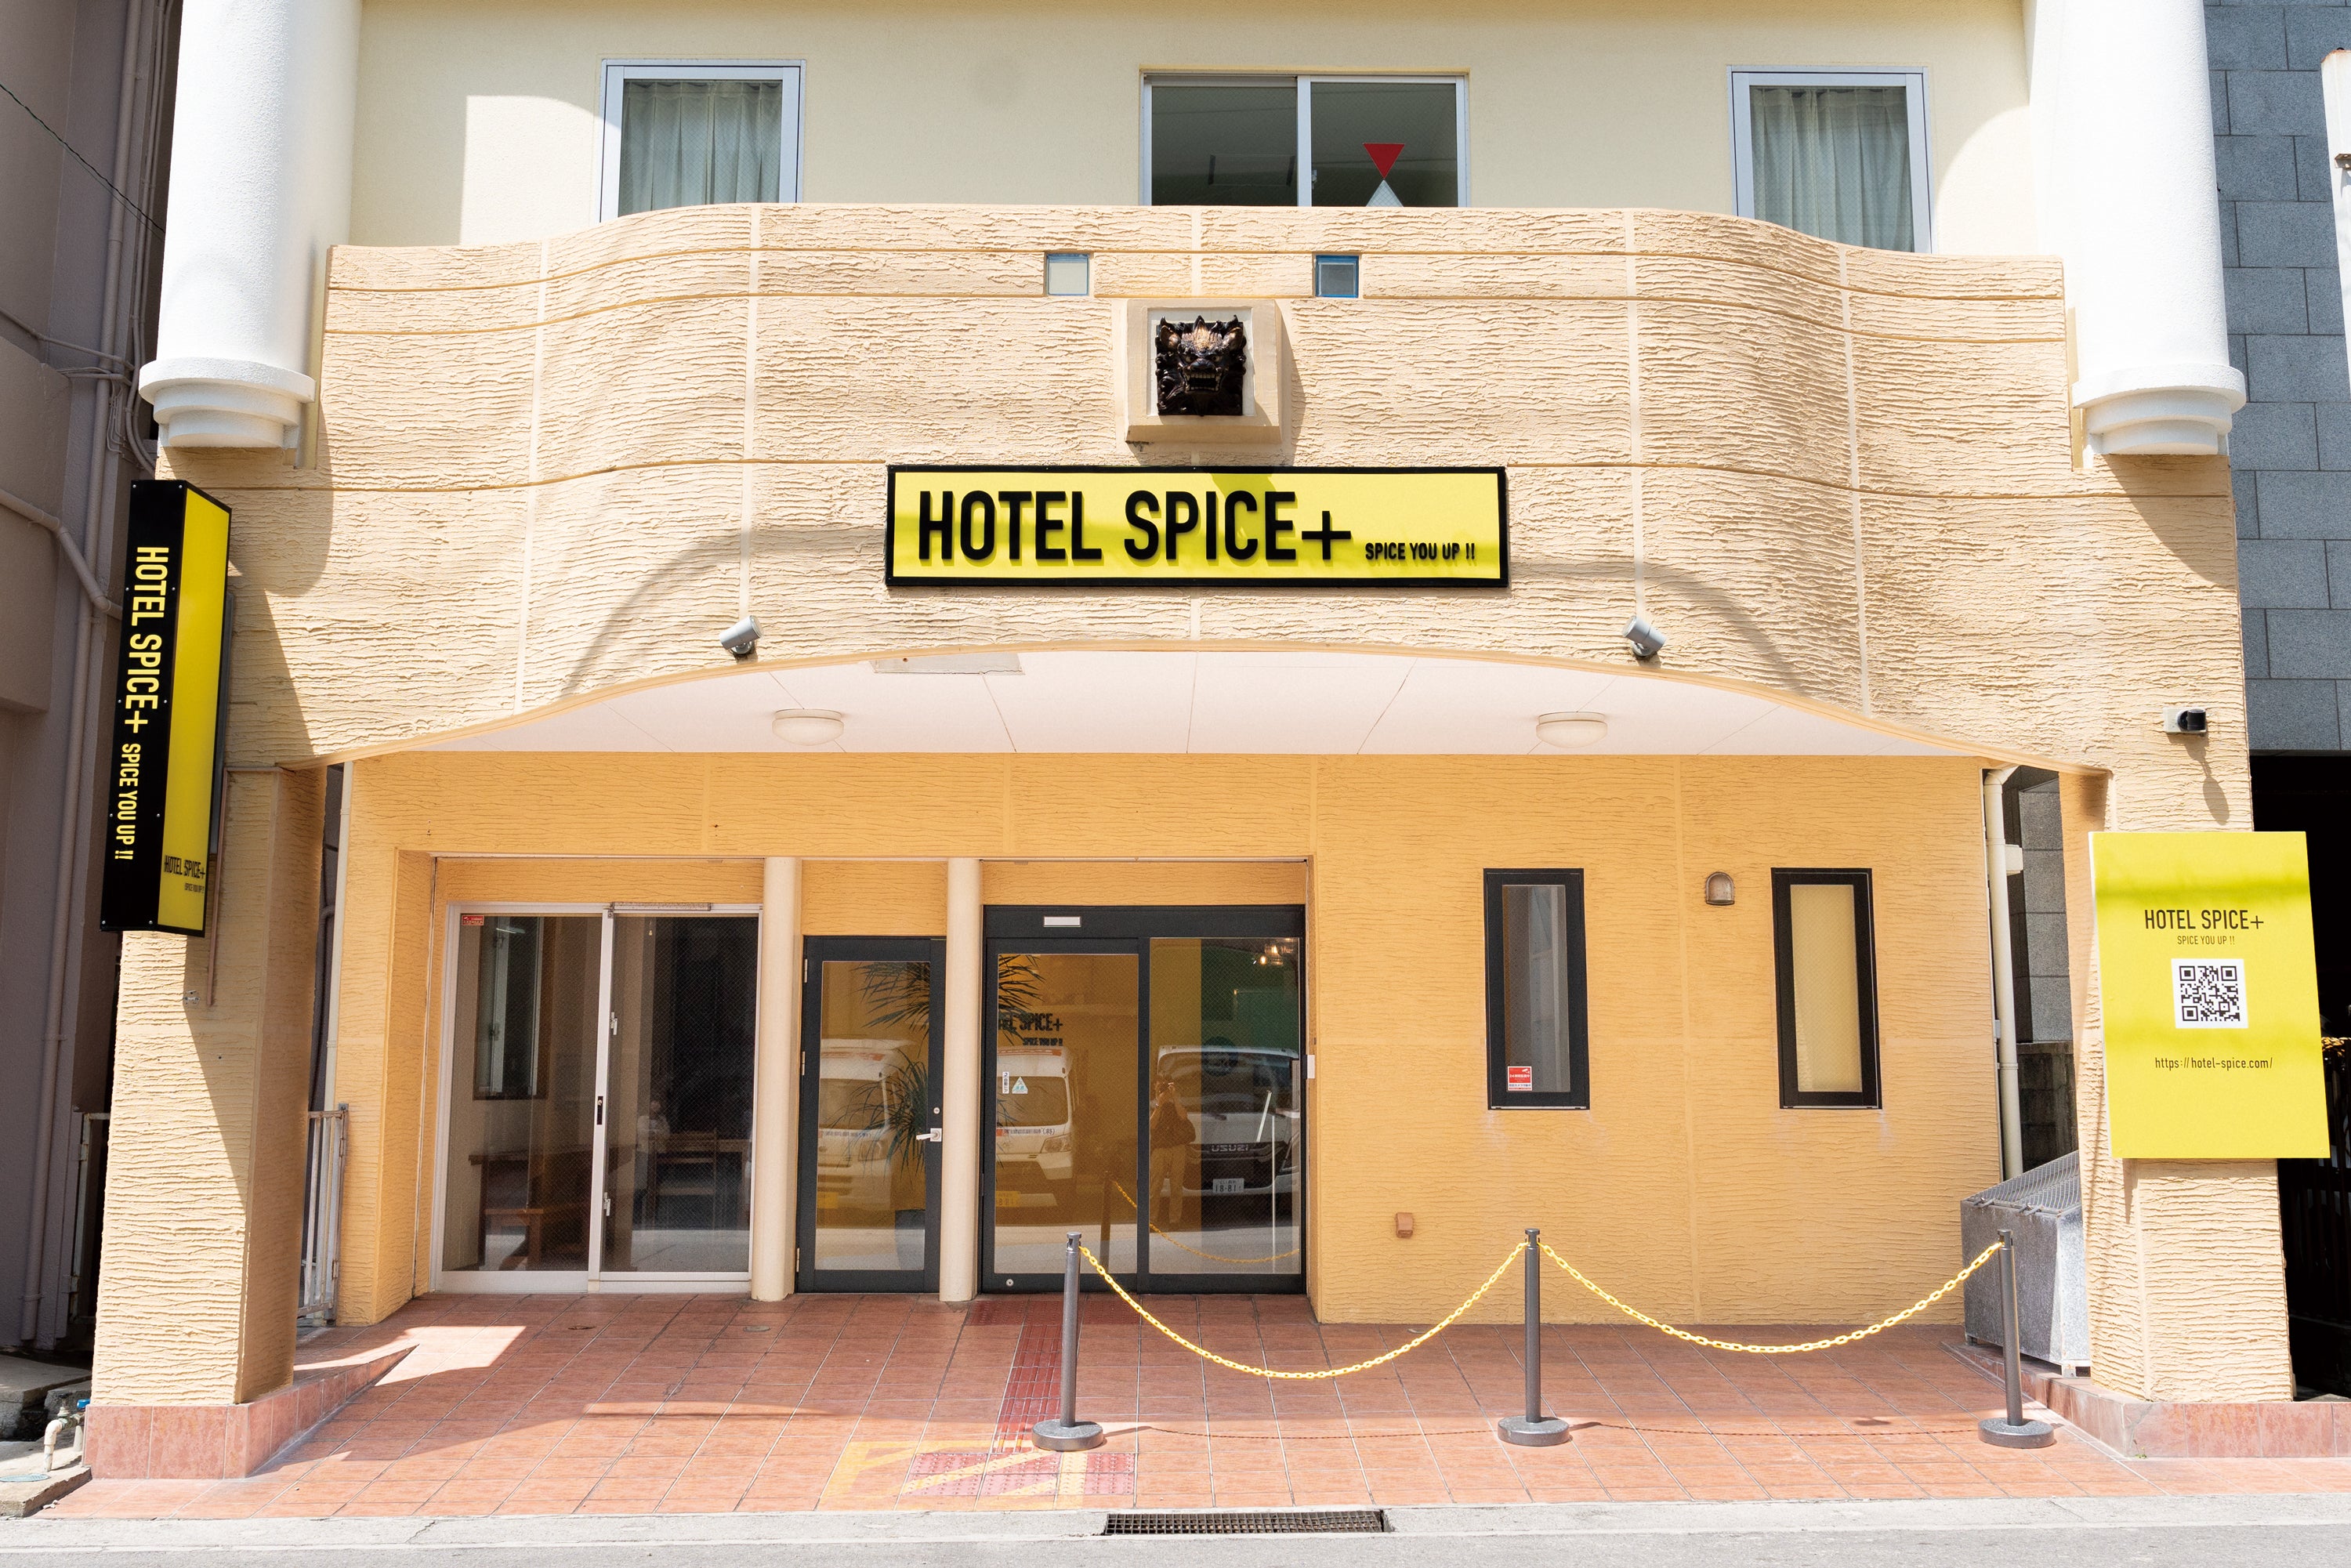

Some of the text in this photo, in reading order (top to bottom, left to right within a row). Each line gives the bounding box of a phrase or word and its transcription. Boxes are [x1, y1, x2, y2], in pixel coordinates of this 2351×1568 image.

[918, 490, 1352, 560] HOTEL SPICE+
[1365, 542, 1475, 560] SPICE YOU UP !!
[125, 547, 169, 733] HOTEL SPICE+
[114, 743, 141, 860] SPICE YOU UP !!
[164, 855, 205, 879] HOTEL SPICE+
[2145, 910, 2264, 929] HOTEL SPICE+
[2177, 936, 2235, 945] SPICE YOU UP !!
[2155, 1057, 2273, 1071] https://hotel-spice.com/
